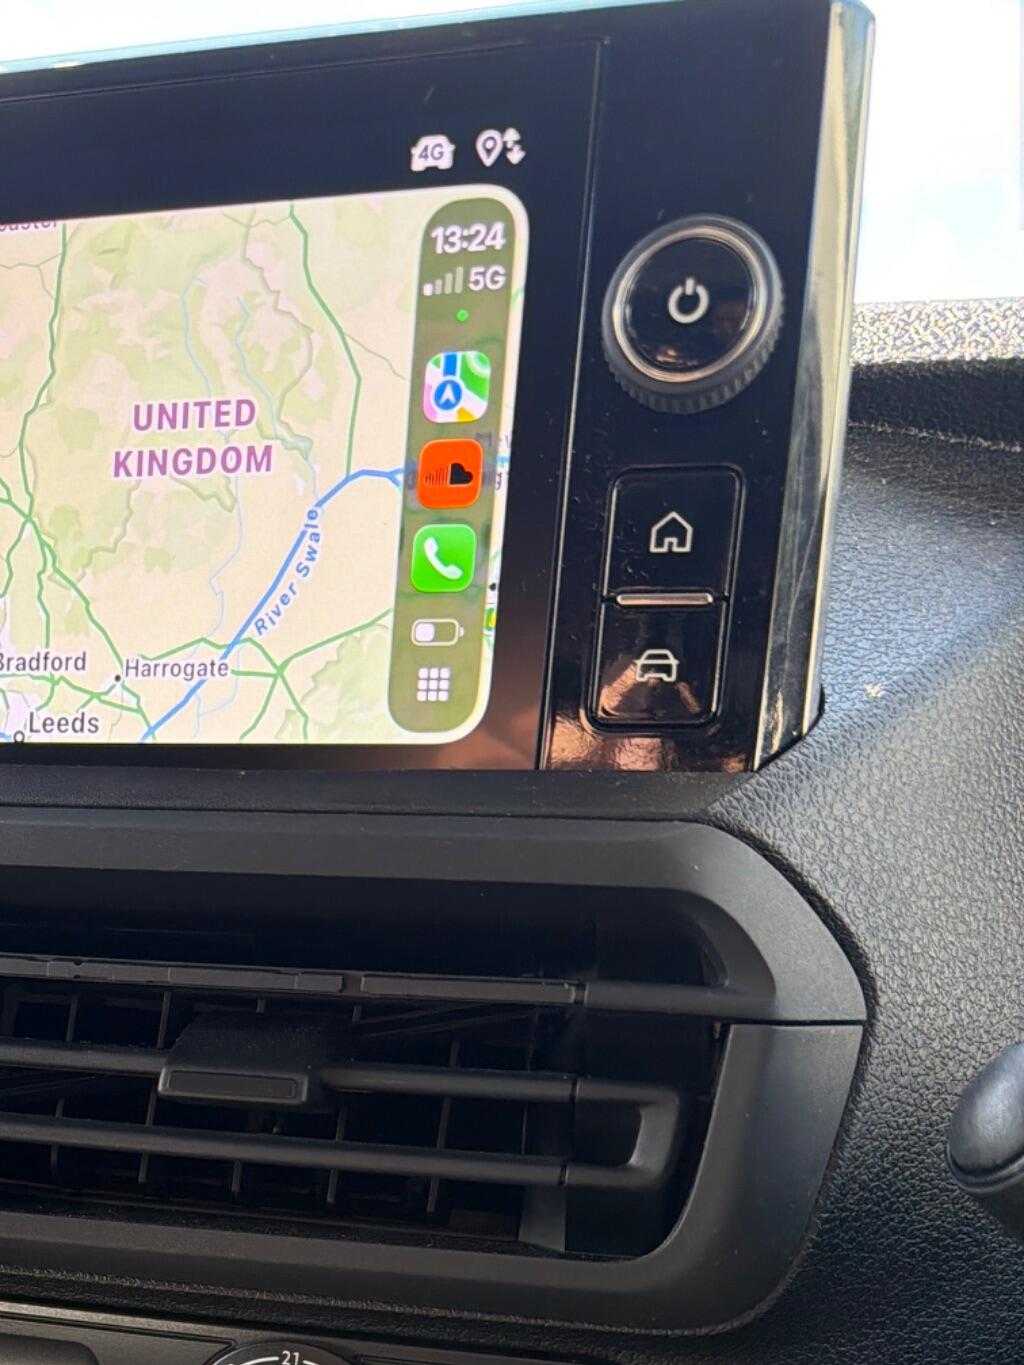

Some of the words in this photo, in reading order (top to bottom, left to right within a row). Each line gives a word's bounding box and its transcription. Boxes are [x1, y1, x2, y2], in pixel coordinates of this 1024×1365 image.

[419, 148, 444, 161] 4G
[431, 222, 506, 254] 13:24
[468, 266, 506, 291] 5G
[133, 399, 256, 431] UNITED
[113, 445, 273, 477] KINGDOM
[254, 580, 298, 636] River
[295, 508, 321, 578] Swale
[124, 658, 229, 680] Harrogate
[28, 712, 100, 735] Leeds
